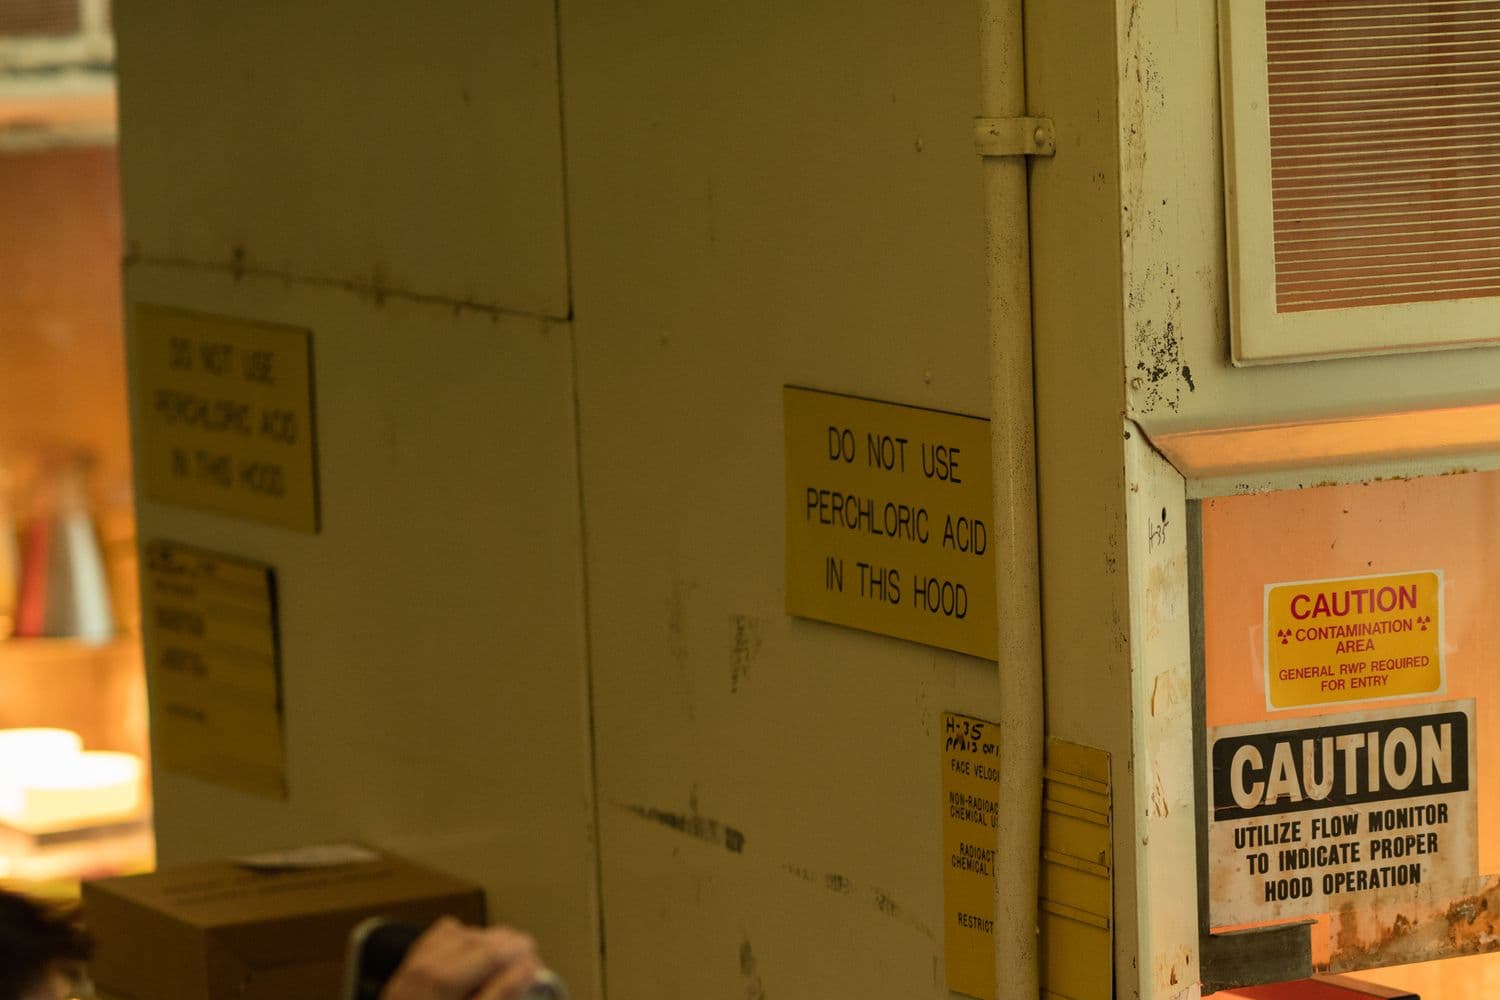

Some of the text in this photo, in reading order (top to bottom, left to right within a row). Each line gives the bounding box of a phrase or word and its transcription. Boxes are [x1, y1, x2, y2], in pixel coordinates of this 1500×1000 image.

[828, 426, 961, 483] DO NOT USE
[807, 487, 987, 555] PERCHLORIC ACID
[826, 555, 968, 619] IN THIS HOOD
[1290, 584, 1417, 620] CAUTION
[1295, 618, 1413, 642] CONTAMINATION
[1335, 638, 1375, 655] AREA
[1278, 655, 1430, 681] GENERAL RWP REQUIRED
[1320, 674, 1389, 692] FOR ENTRY
[946, 715, 984, 740] H-35
[951, 759, 970, 776] FACE
[1230, 722, 1453, 810] CAUTION
[951, 804, 987, 826] CHEMICAL
[1234, 803, 1448, 850] UTILIZE FLOW MONITOR
[952, 854, 989, 876] CHEMICAL
[1246, 832, 1438, 875] TO INDICATE PROPER
[1265, 863, 1421, 902] HOOD OPERATION
